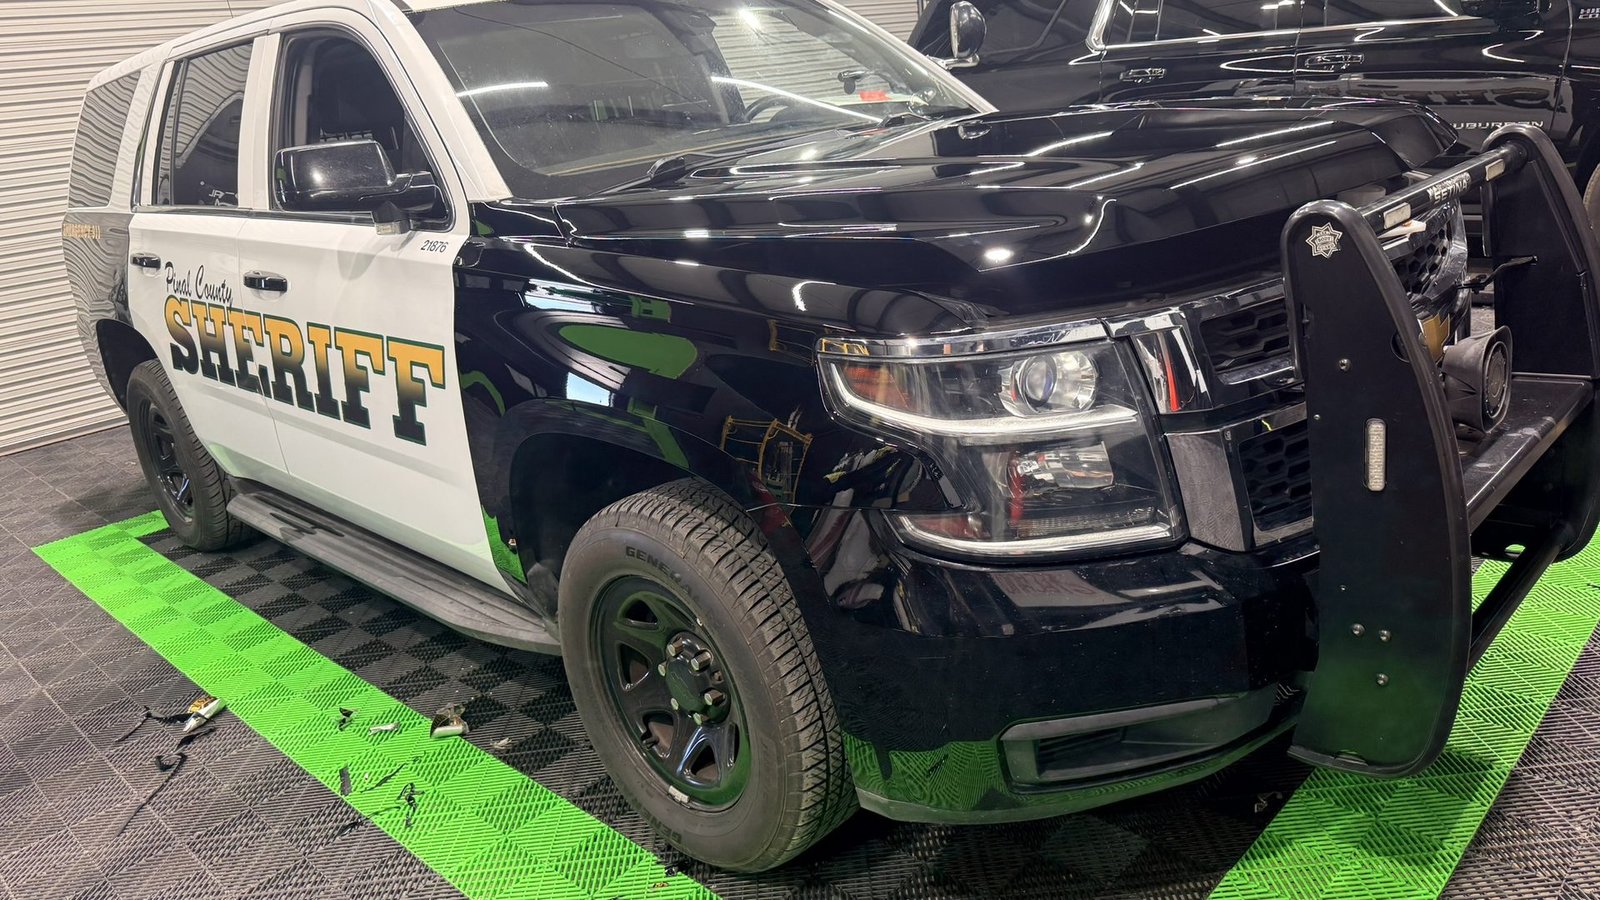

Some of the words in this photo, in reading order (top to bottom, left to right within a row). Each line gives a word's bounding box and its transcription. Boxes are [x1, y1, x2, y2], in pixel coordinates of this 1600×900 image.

[1434, 179, 1468, 205] SETINA
[420, 239, 449, 253] 21876
[164, 261, 193, 297] Pinal
[195, 265, 234, 308] County
[164, 294, 446, 446] SHERIFF
